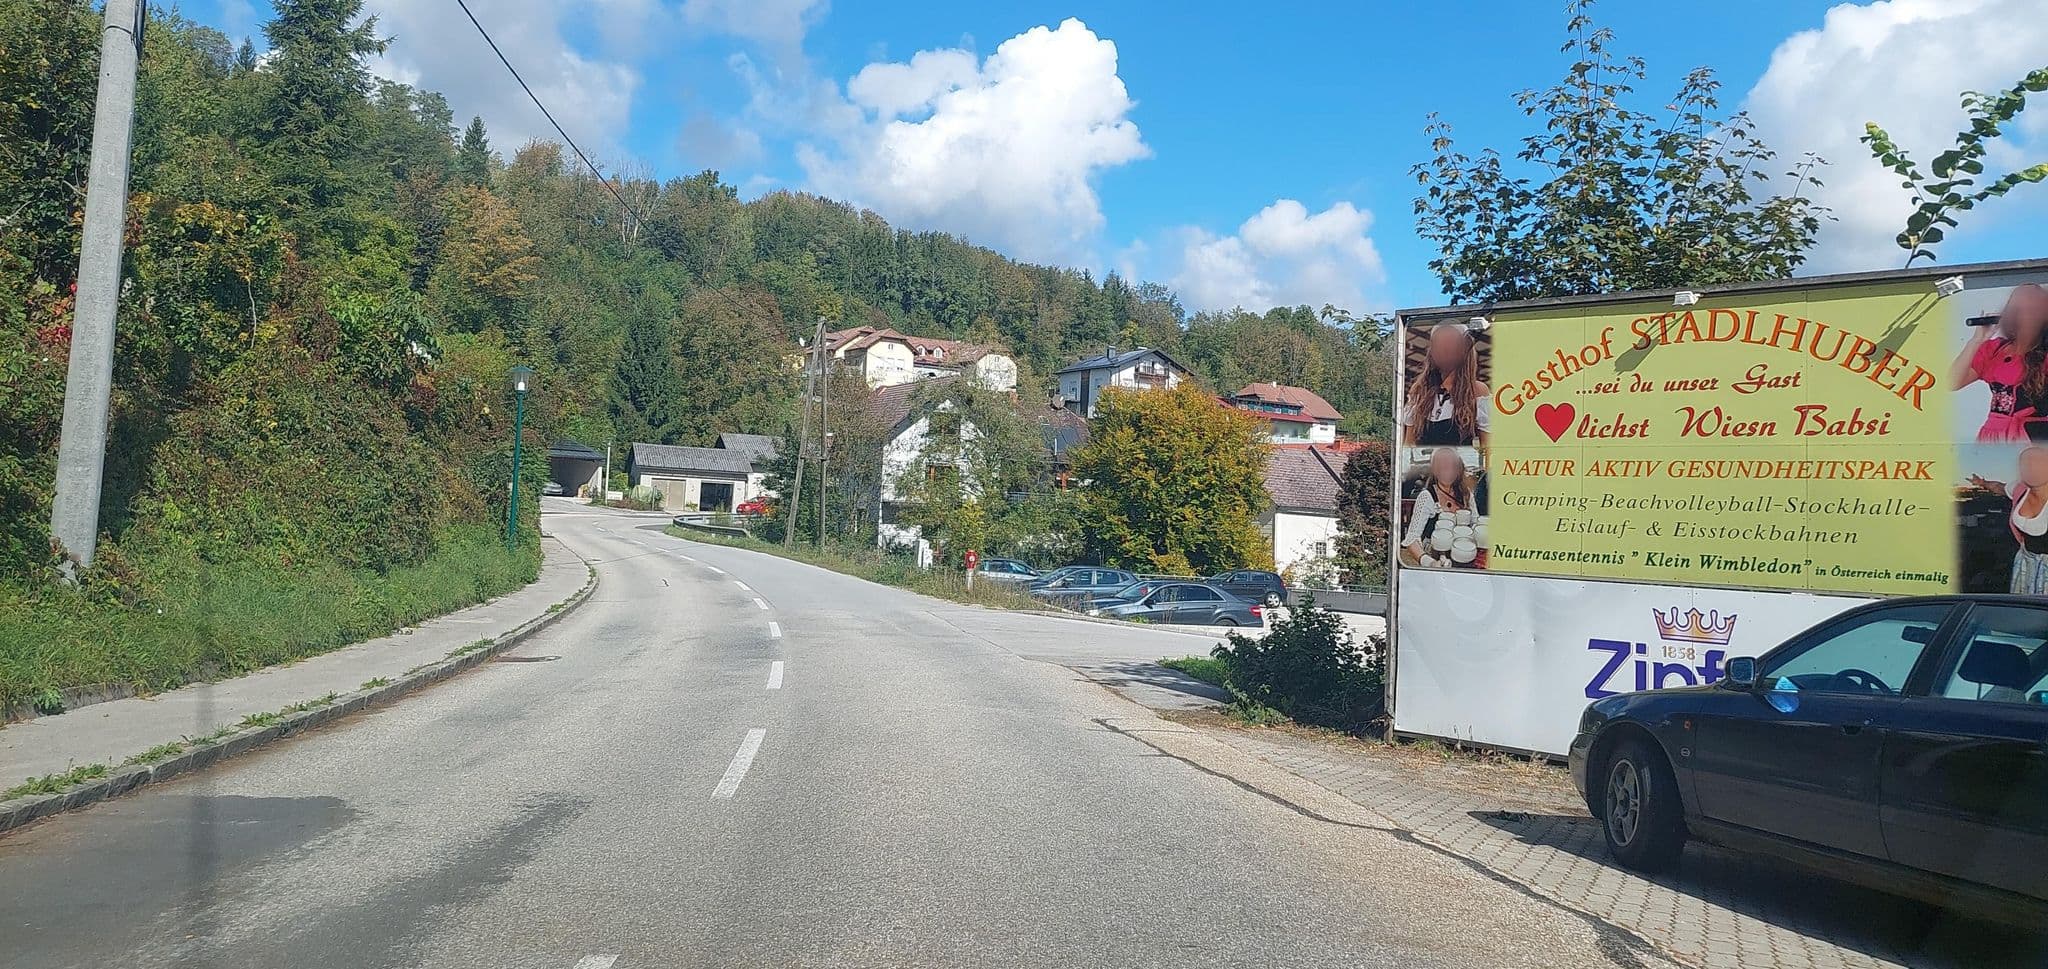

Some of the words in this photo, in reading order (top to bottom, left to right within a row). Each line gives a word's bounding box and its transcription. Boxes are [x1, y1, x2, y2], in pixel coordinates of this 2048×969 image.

[1495, 326, 1614, 415] Gasthof
[1631, 309, 1936, 411] STADLHUBER
[1630, 373, 1654, 393] du
[1664, 378, 1719, 392] unser
[1731, 364, 1802, 393] Gast
[1576, 413, 1650, 438] lichst
[1675, 406, 1777, 437] Wiesn
[1793, 405, 1892, 436] Babsi
[1502, 459, 1576, 477] NATUR
[1584, 460, 1662, 478] AKTIV
[1667, 460, 1936, 480] GESUNDHEITSPARK
[1555, 517, 1636, 539] Eislauf-
[1646, 521, 1662, 537] &
[1673, 521, 1858, 544] Eisstockbahnen
[1493, 544, 1625, 565] Naturrasentennis
[1644, 552, 1690, 568] Klein
[1815, 566, 1827, 576] in
[1831, 565, 1891, 580] Österreich
[1895, 571, 1949, 585] einmalig
[1662, 645, 1696, 661] 1858
